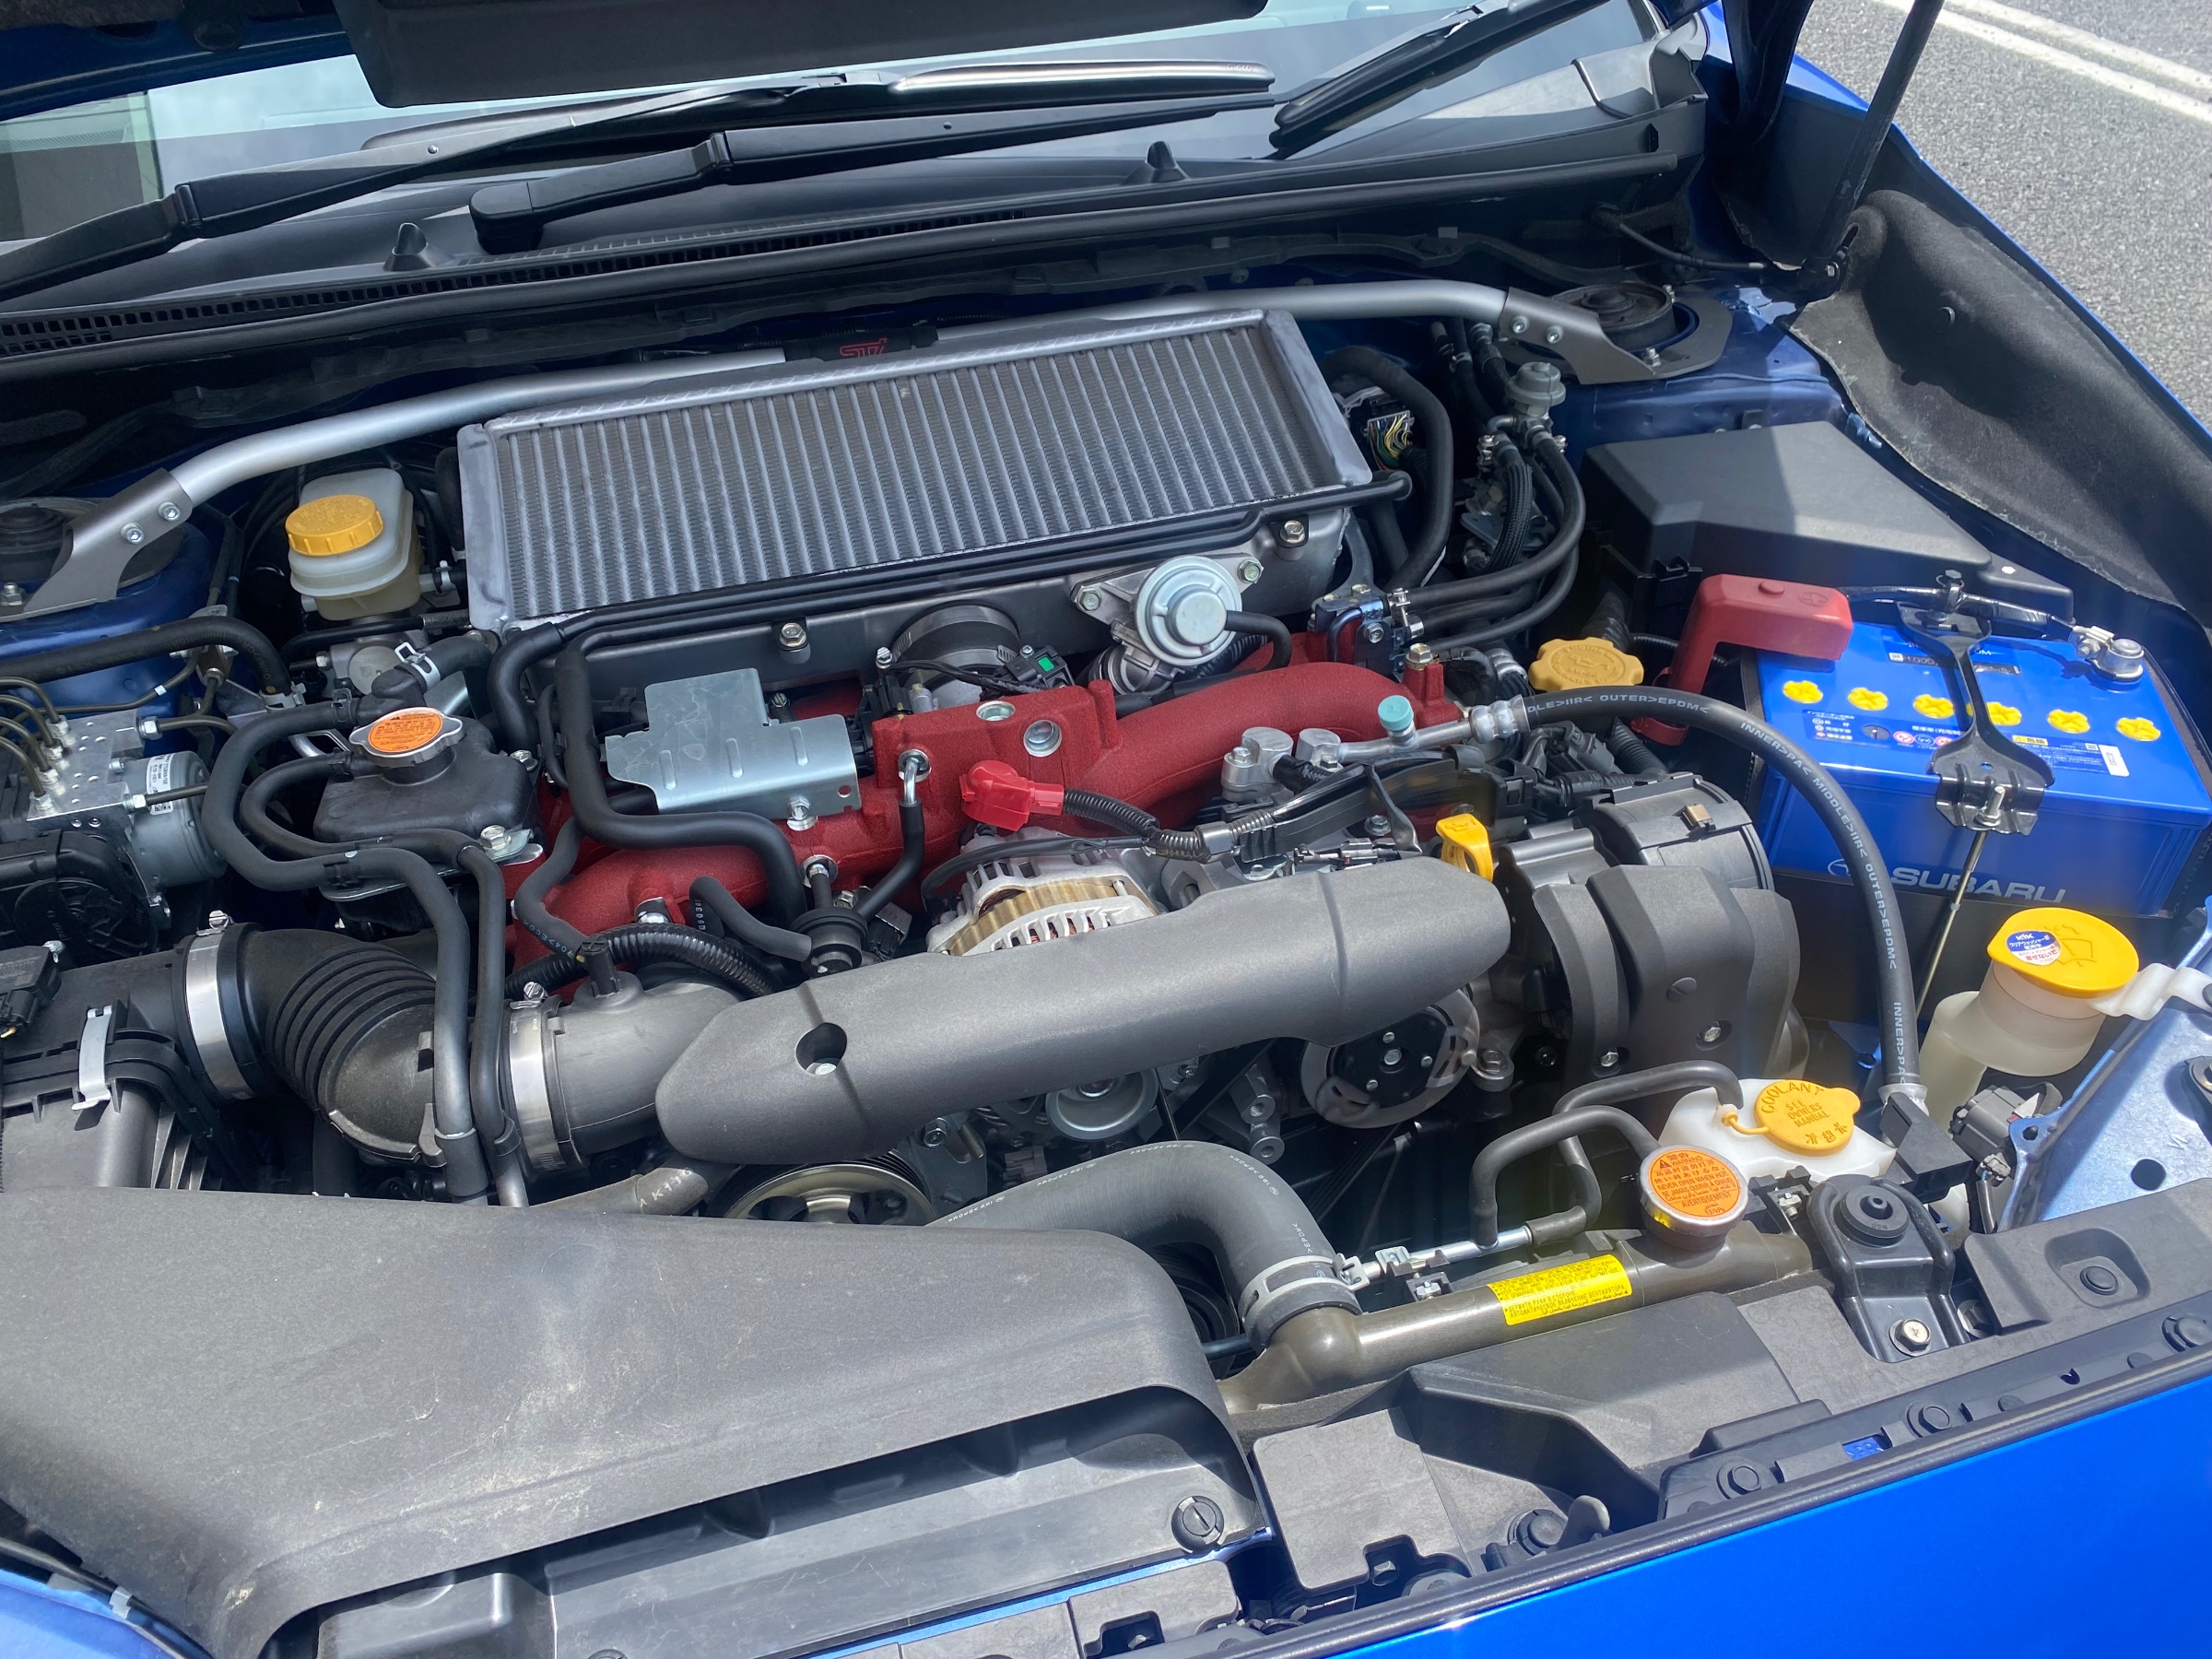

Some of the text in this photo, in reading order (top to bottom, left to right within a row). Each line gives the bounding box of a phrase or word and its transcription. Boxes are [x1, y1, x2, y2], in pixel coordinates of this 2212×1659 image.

[1599, 694, 1710, 714] OUTER>EPDM<
[1740, 722, 1812, 776] INNER>PA<
[1812, 777, 1868, 858] MIDDLE>IIR<
[1865, 864, 1897, 970] OUTER>EPDM<
[1890, 866, 2066, 903] SUBARU
[1760, 1081, 1825, 1113] COOLANT
[1785, 1099, 1806, 1112] SEE
[1794, 1111, 1830, 1127] MANUAL
[1657, 1182, 1678, 1191] NEVER
[1677, 1178, 1696, 1187] OPEN
[1696, 1173, 1714, 1182] WHEN
